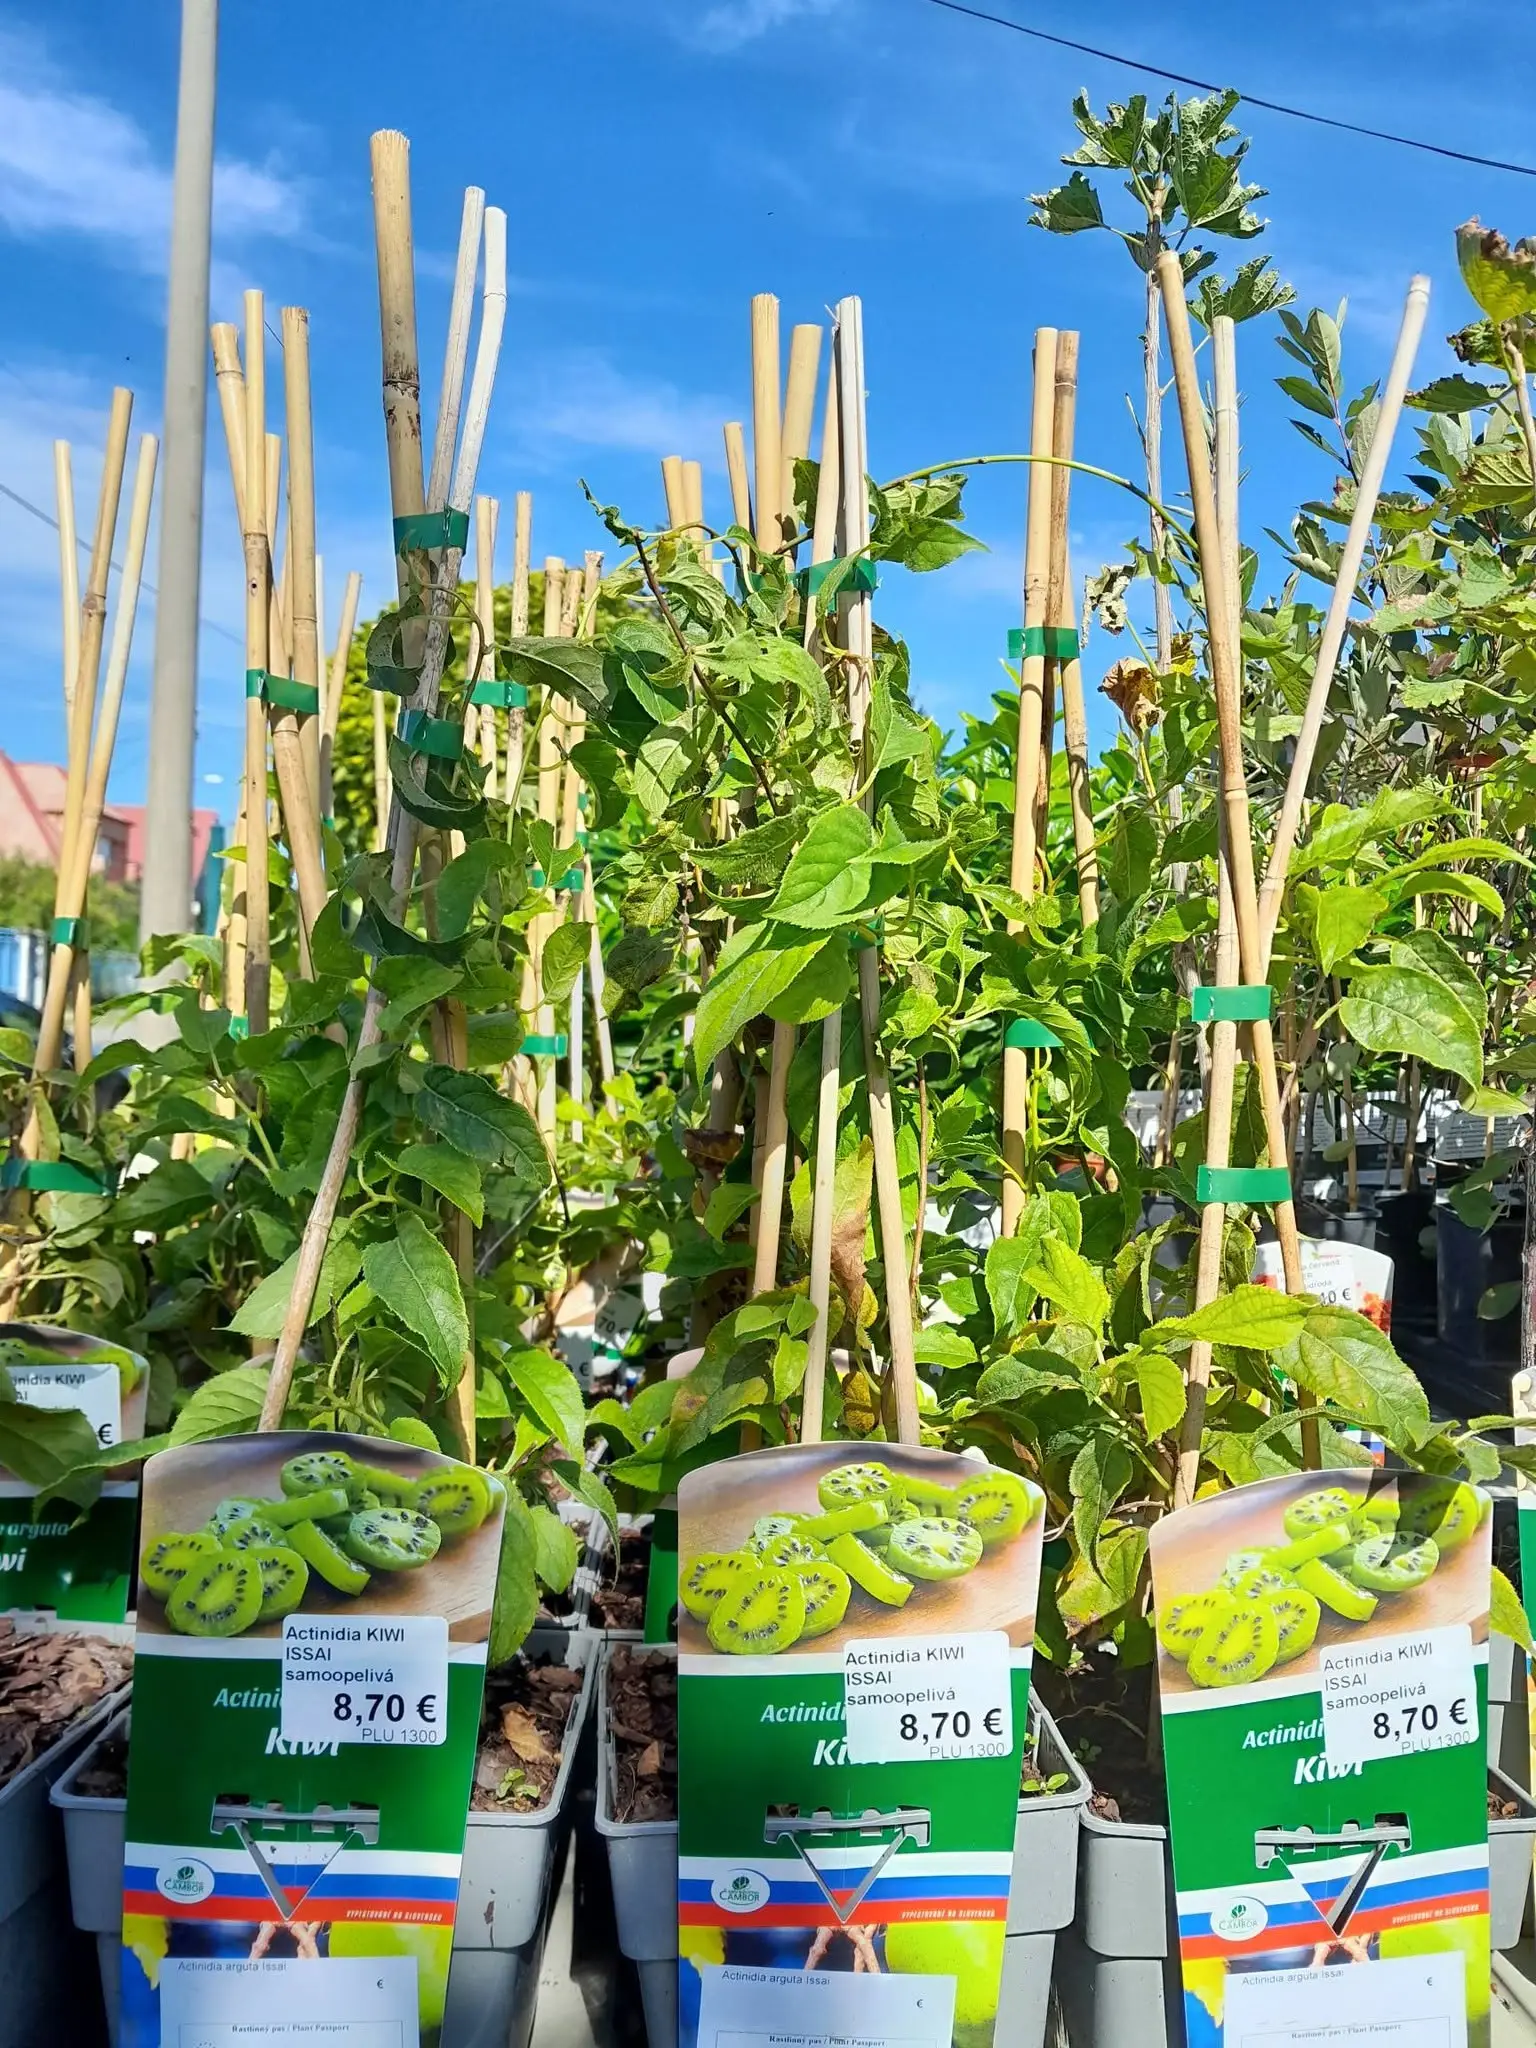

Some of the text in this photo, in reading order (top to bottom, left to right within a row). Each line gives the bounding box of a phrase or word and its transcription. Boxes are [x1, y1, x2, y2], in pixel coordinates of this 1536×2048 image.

[55, 1374, 85, 1385] KIWI
[98, 1423, 113, 1445] €
[286, 1626, 404, 1642] Actinidia KIWI
[286, 1647, 331, 1661] ISSAI
[846, 1646, 964, 1666] Actinidia KIWI
[1324, 1642, 1433, 1671] Actinidia KIWI
[286, 1669, 394, 1684] samoopelivá
[846, 1671, 891, 1686] ISSAI
[1325, 1673, 1367, 1691] ISSAI
[213, 1687, 281, 1708] Actini
[847, 1687, 955, 1706] samoopelivá
[1326, 1682, 1426, 1710] samoopelivá
[334, 1693, 437, 1726] 8,70 €
[760, 1702, 846, 1722] Actinidi
[900, 1708, 1003, 1745] 8,70 €
[1373, 1698, 1468, 1742] 8,70 €
[362, 1728, 437, 1743] PLU 1300
[1242, 1718, 1324, 1749] Actinidi
[1402, 1731, 1471, 1753] PLU 1300
[929, 1743, 1005, 1759] PLU 1300
[178, 1961, 287, 1974] Actinidia arguta Issai
[376, 1978, 385, 1990] €
[721, 1970, 831, 1986] Actinidia arguta Issai
[1241, 1976, 1284, 1987] Actinidia
[1287, 1972, 1319, 1984] arguta
[1426, 1976, 1434, 1987] €
[916, 1998, 924, 2009] €
